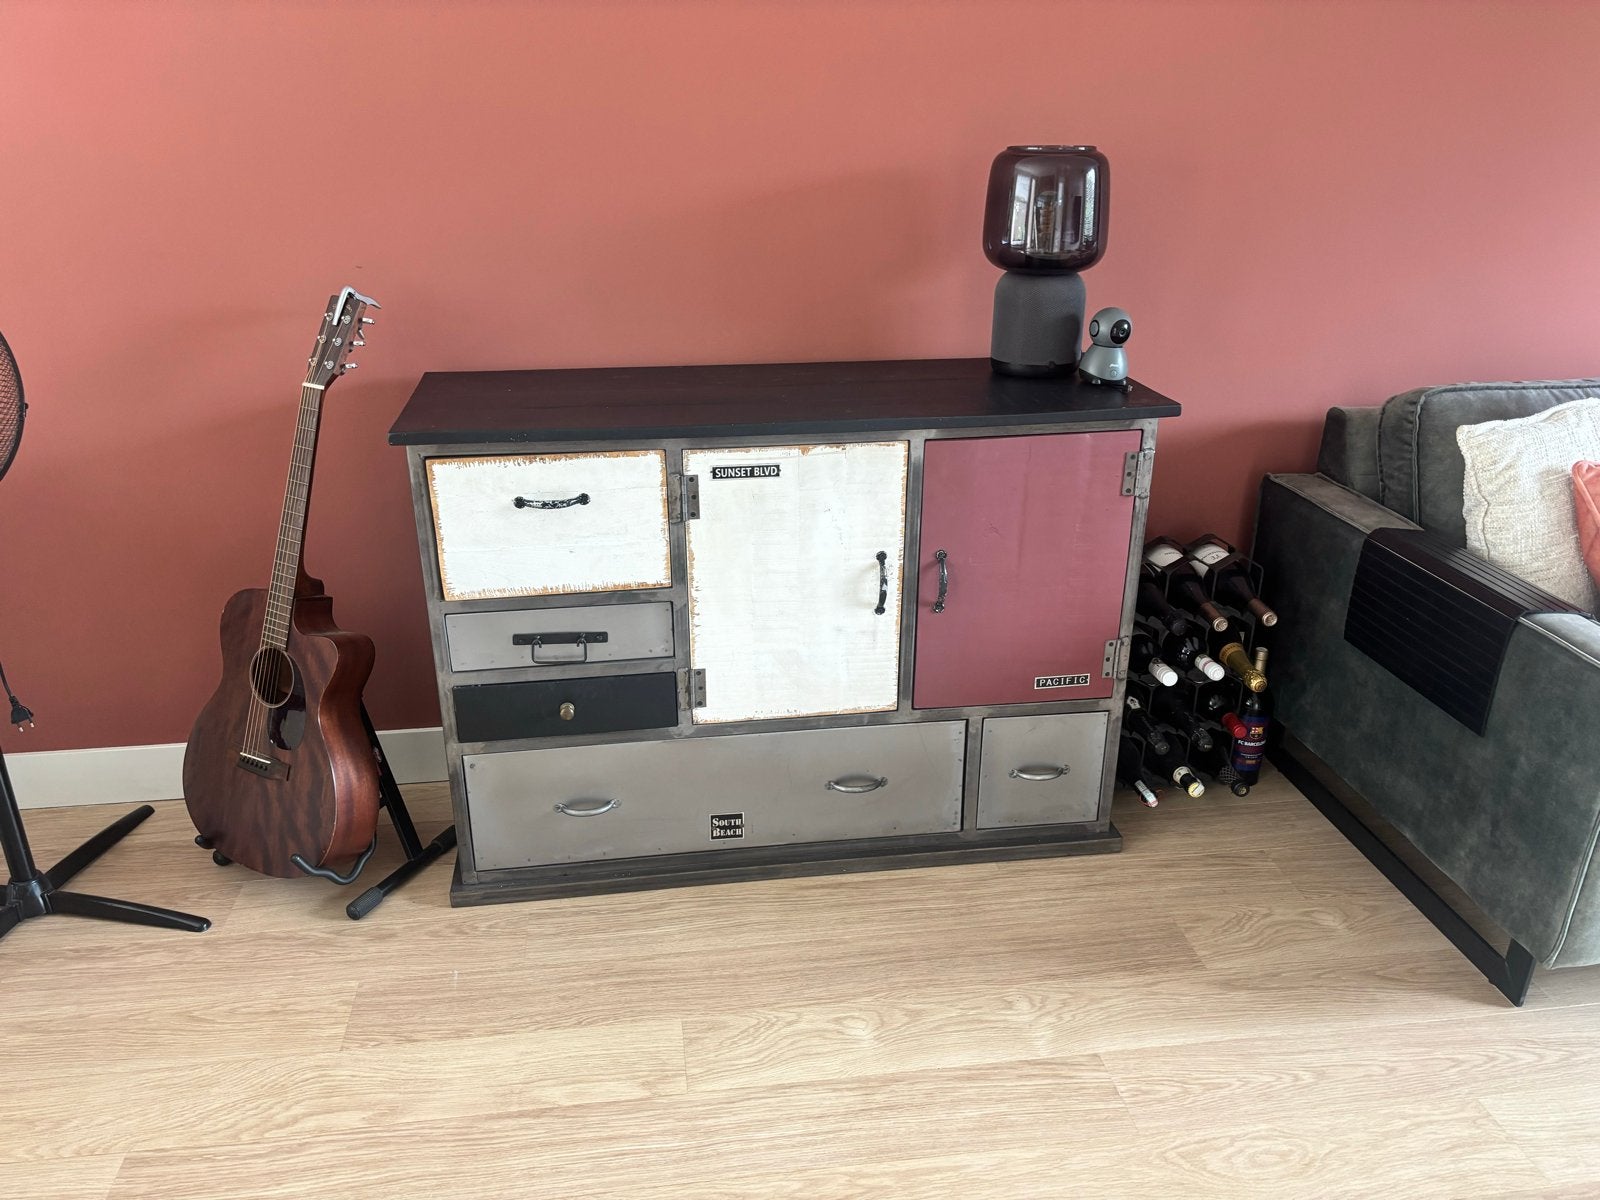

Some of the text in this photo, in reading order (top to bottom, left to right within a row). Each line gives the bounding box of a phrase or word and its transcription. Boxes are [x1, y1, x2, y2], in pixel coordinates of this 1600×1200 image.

[715, 466, 778, 478] SUNSET BLVD
[1039, 676, 1086, 687] PACIFIC
[712, 817, 742, 827] SOUTH
[712, 827, 742, 837] BEACH
